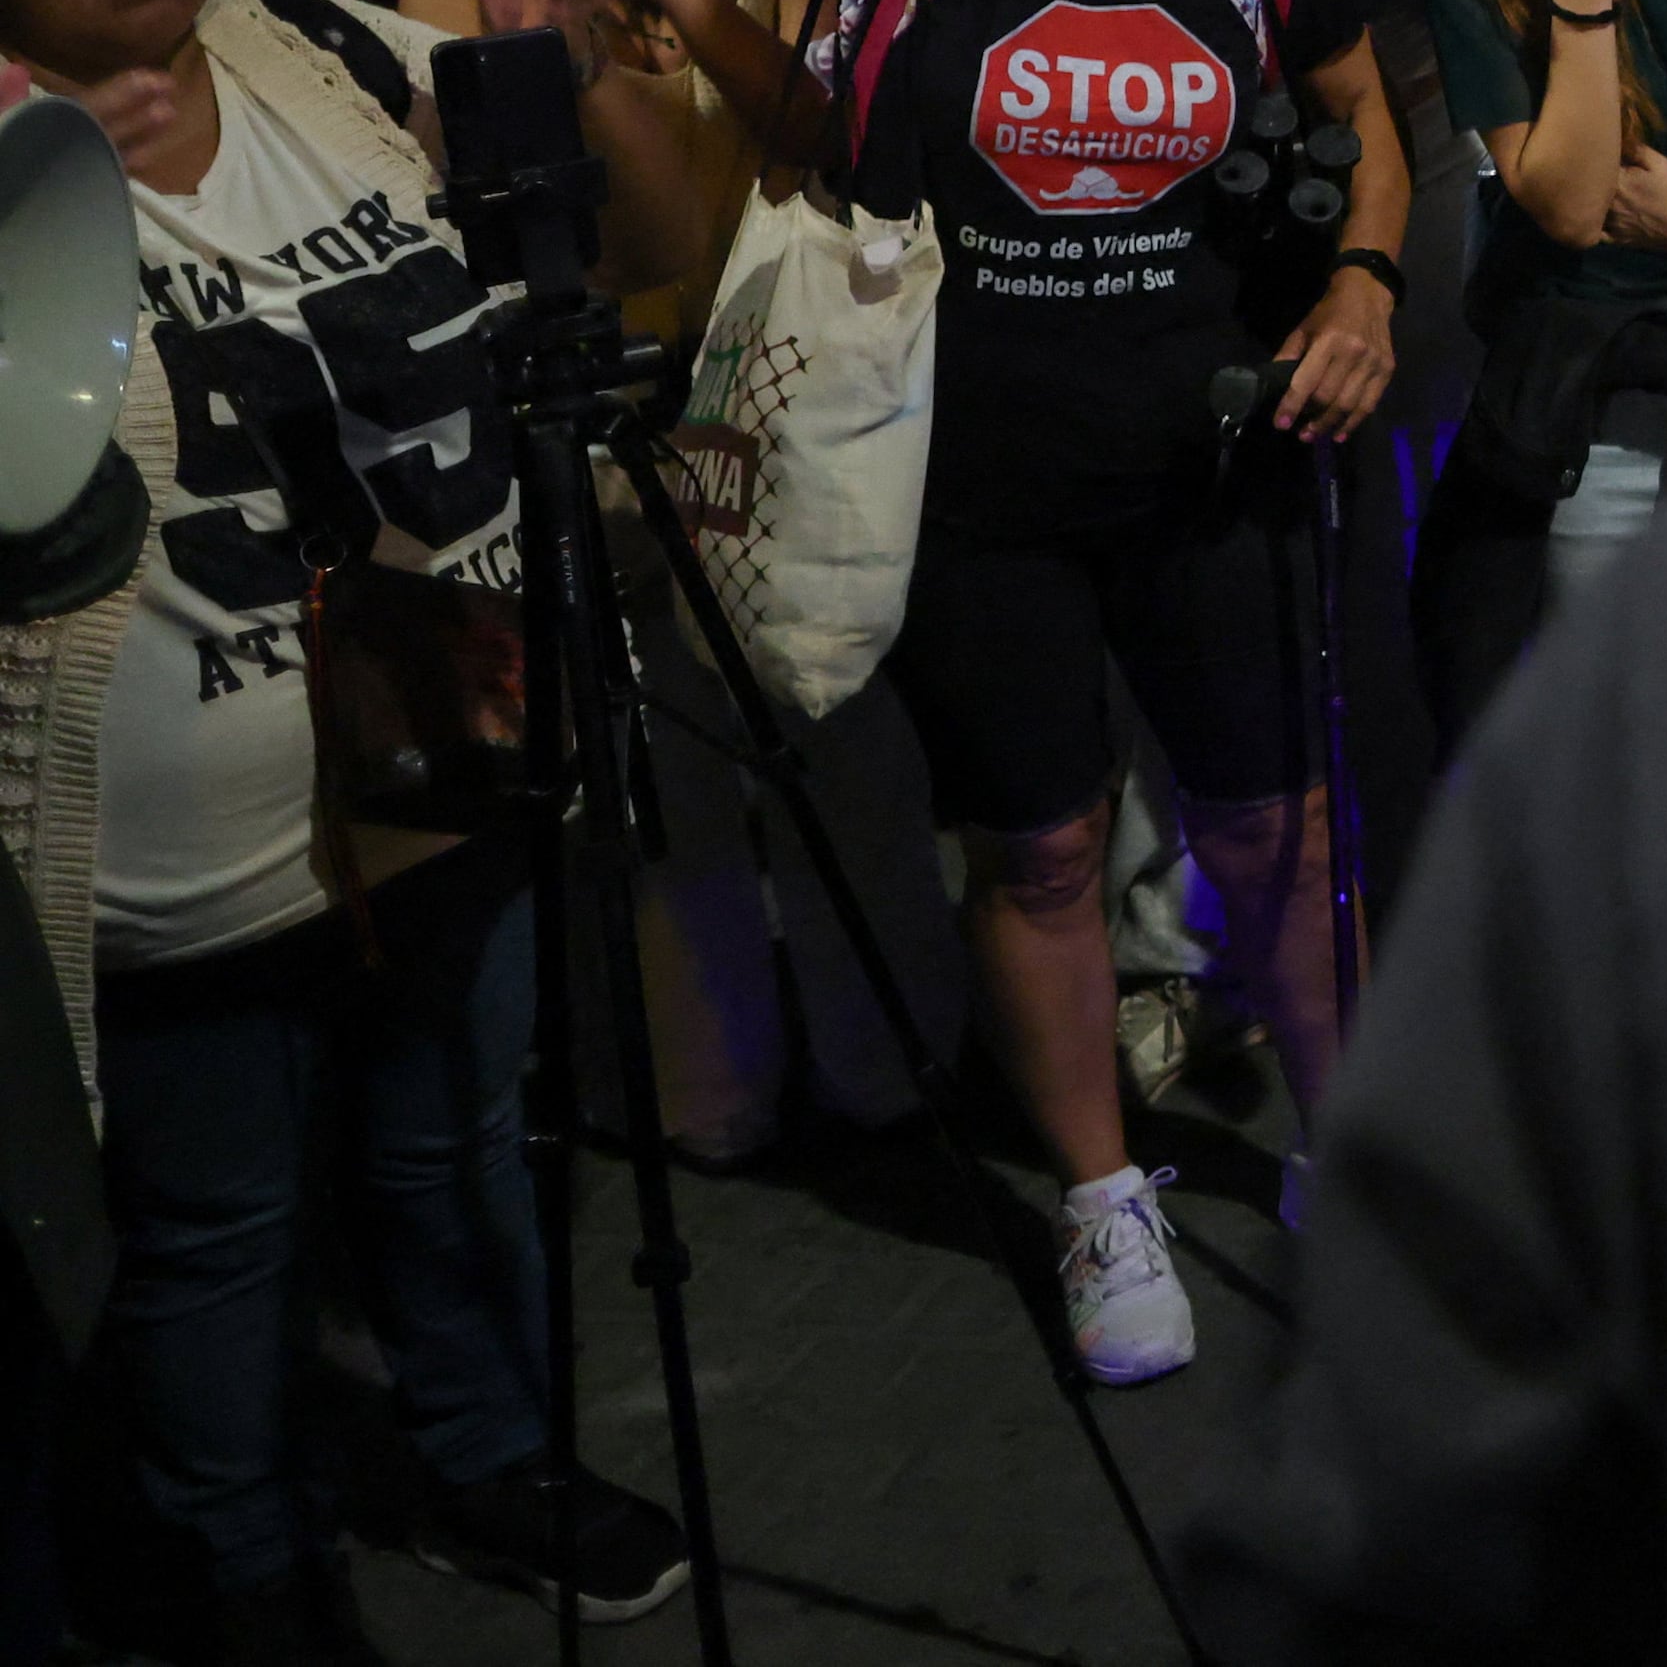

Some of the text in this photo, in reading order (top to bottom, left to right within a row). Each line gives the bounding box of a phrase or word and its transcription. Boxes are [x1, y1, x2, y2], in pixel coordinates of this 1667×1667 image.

[1000, 48, 1217, 129] STOP
[995, 123, 1212, 163] DESAHUCIOS
[260, 191, 430, 284] YORK
[958, 226, 1192, 260] Grupo de Vivienda
[976, 267, 1177, 298] Pueblos del Sur
